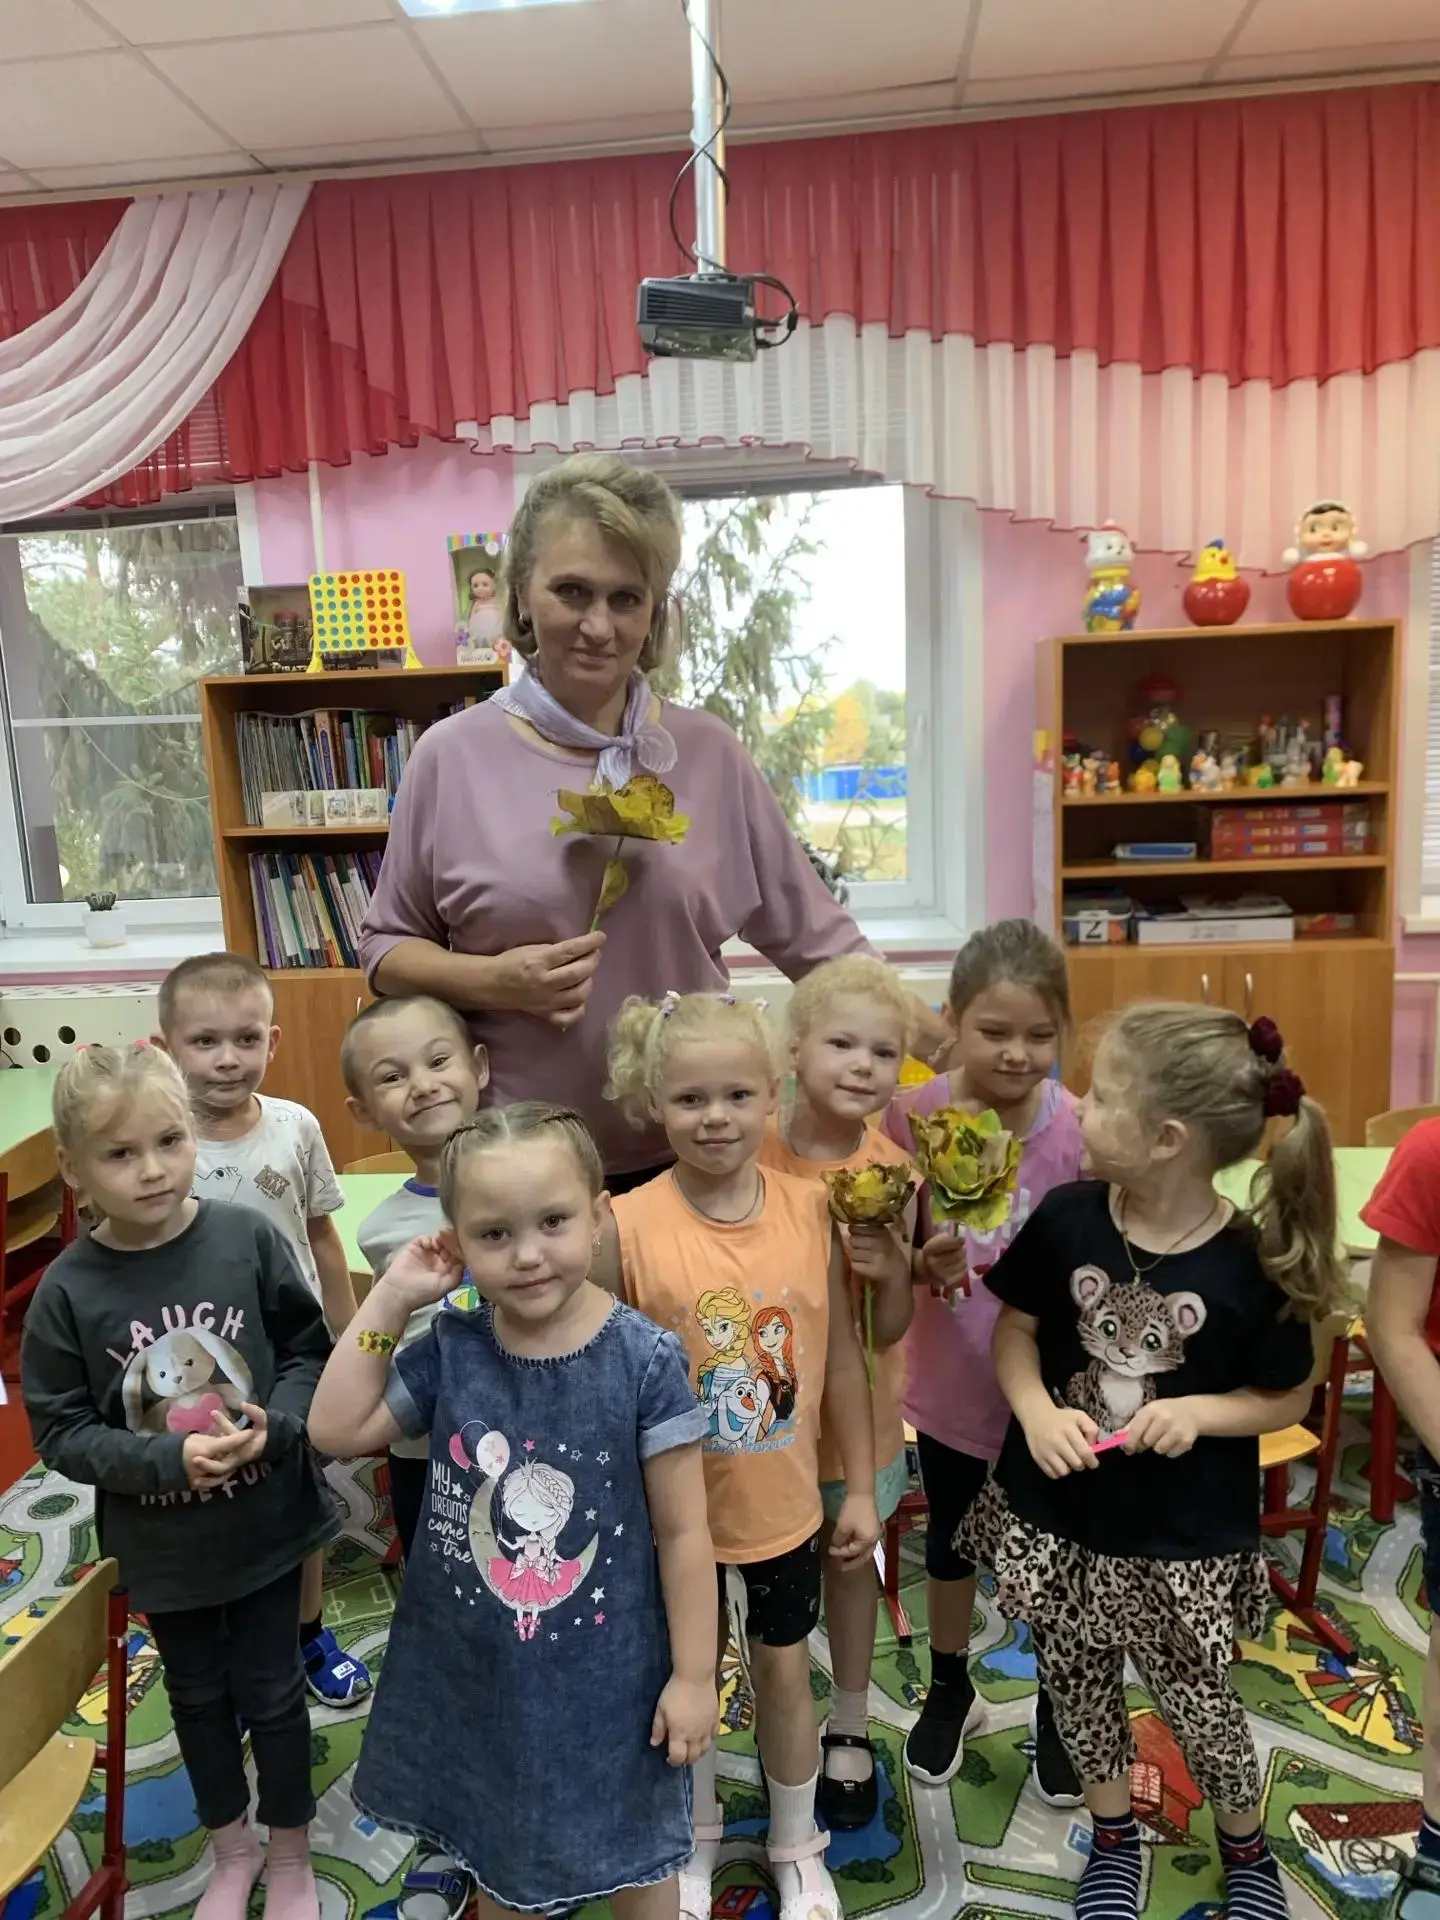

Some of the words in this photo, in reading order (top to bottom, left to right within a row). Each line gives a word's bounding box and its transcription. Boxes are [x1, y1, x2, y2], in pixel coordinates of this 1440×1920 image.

[106, 1301, 245, 1370] LAUGH
[432, 1458, 450, 1495] MY
[431, 1493, 468, 1524] DREAMS
[428, 1517, 467, 1541] come
[440, 1537, 472, 1562] true
